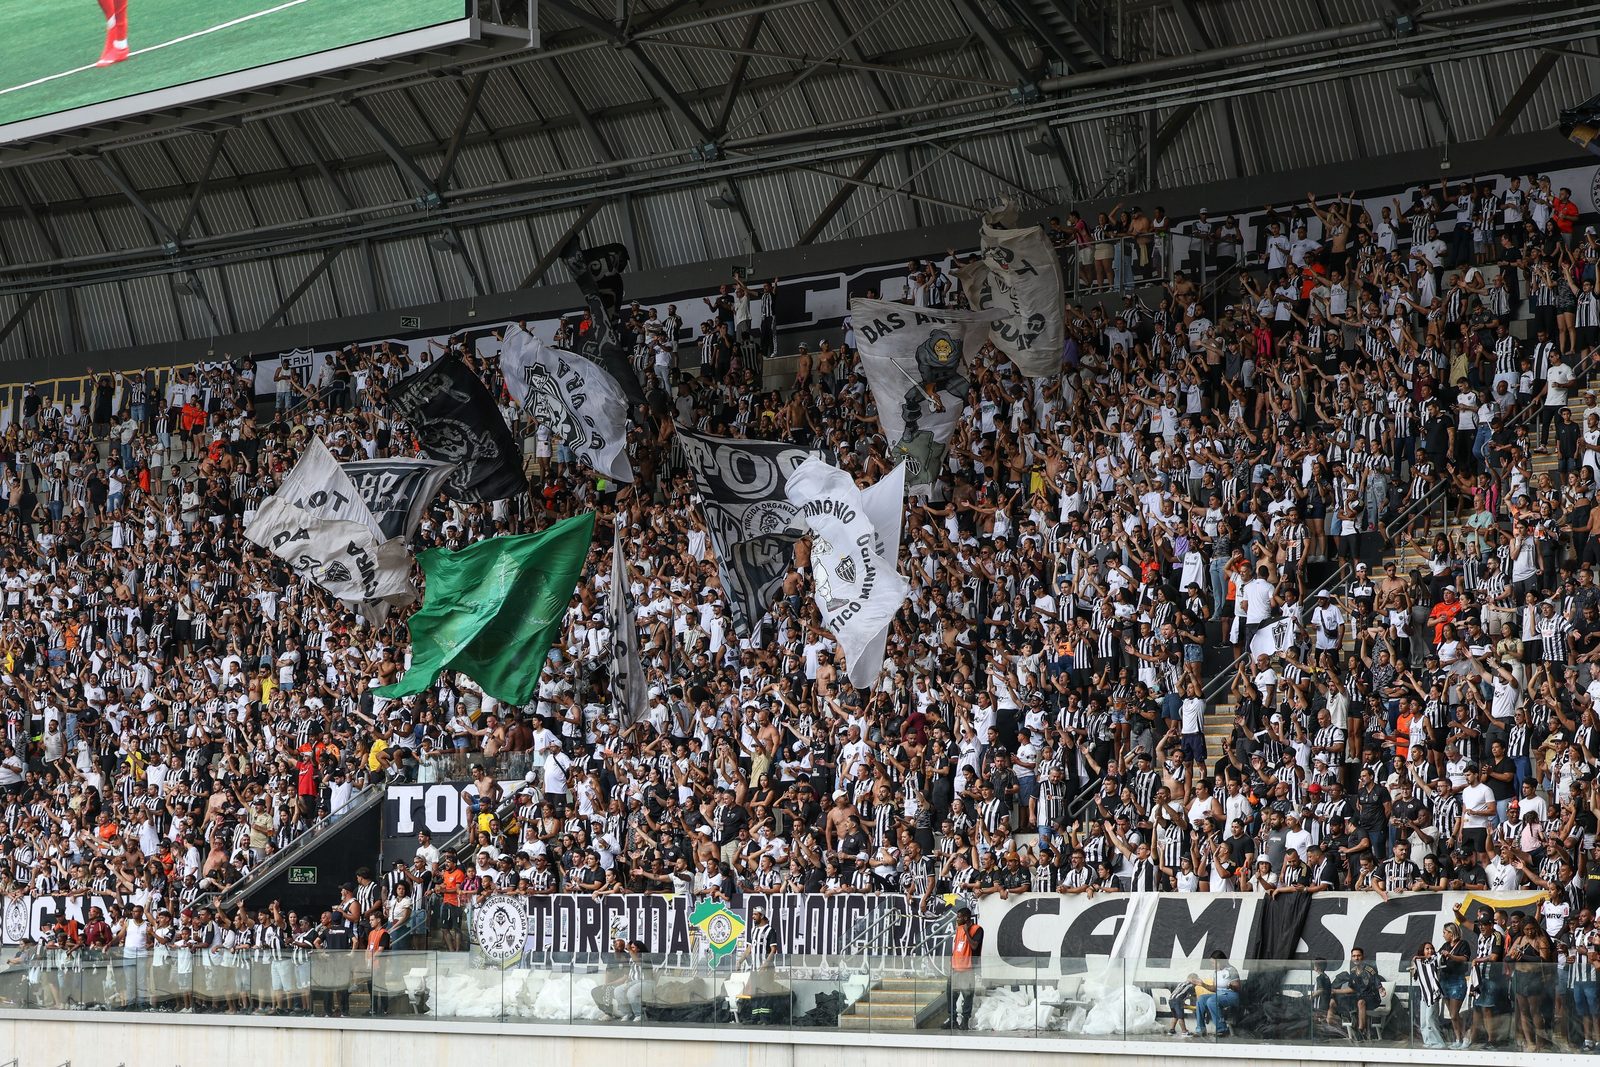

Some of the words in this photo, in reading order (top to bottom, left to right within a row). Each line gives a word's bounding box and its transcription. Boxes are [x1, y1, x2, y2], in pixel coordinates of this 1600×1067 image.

[860, 312, 906, 345] DAS
[744, 505, 761, 531] TORCIDA
[272, 527, 310, 551] DA
[487, 897, 506, 909] TORCIDA
[506, 897, 526, 931] ORGANIZADA
[527, 894, 693, 968] TORCIDA
[996, 897, 1443, 976] CAMISA
[481, 938, 525, 959] GALOUCURA
